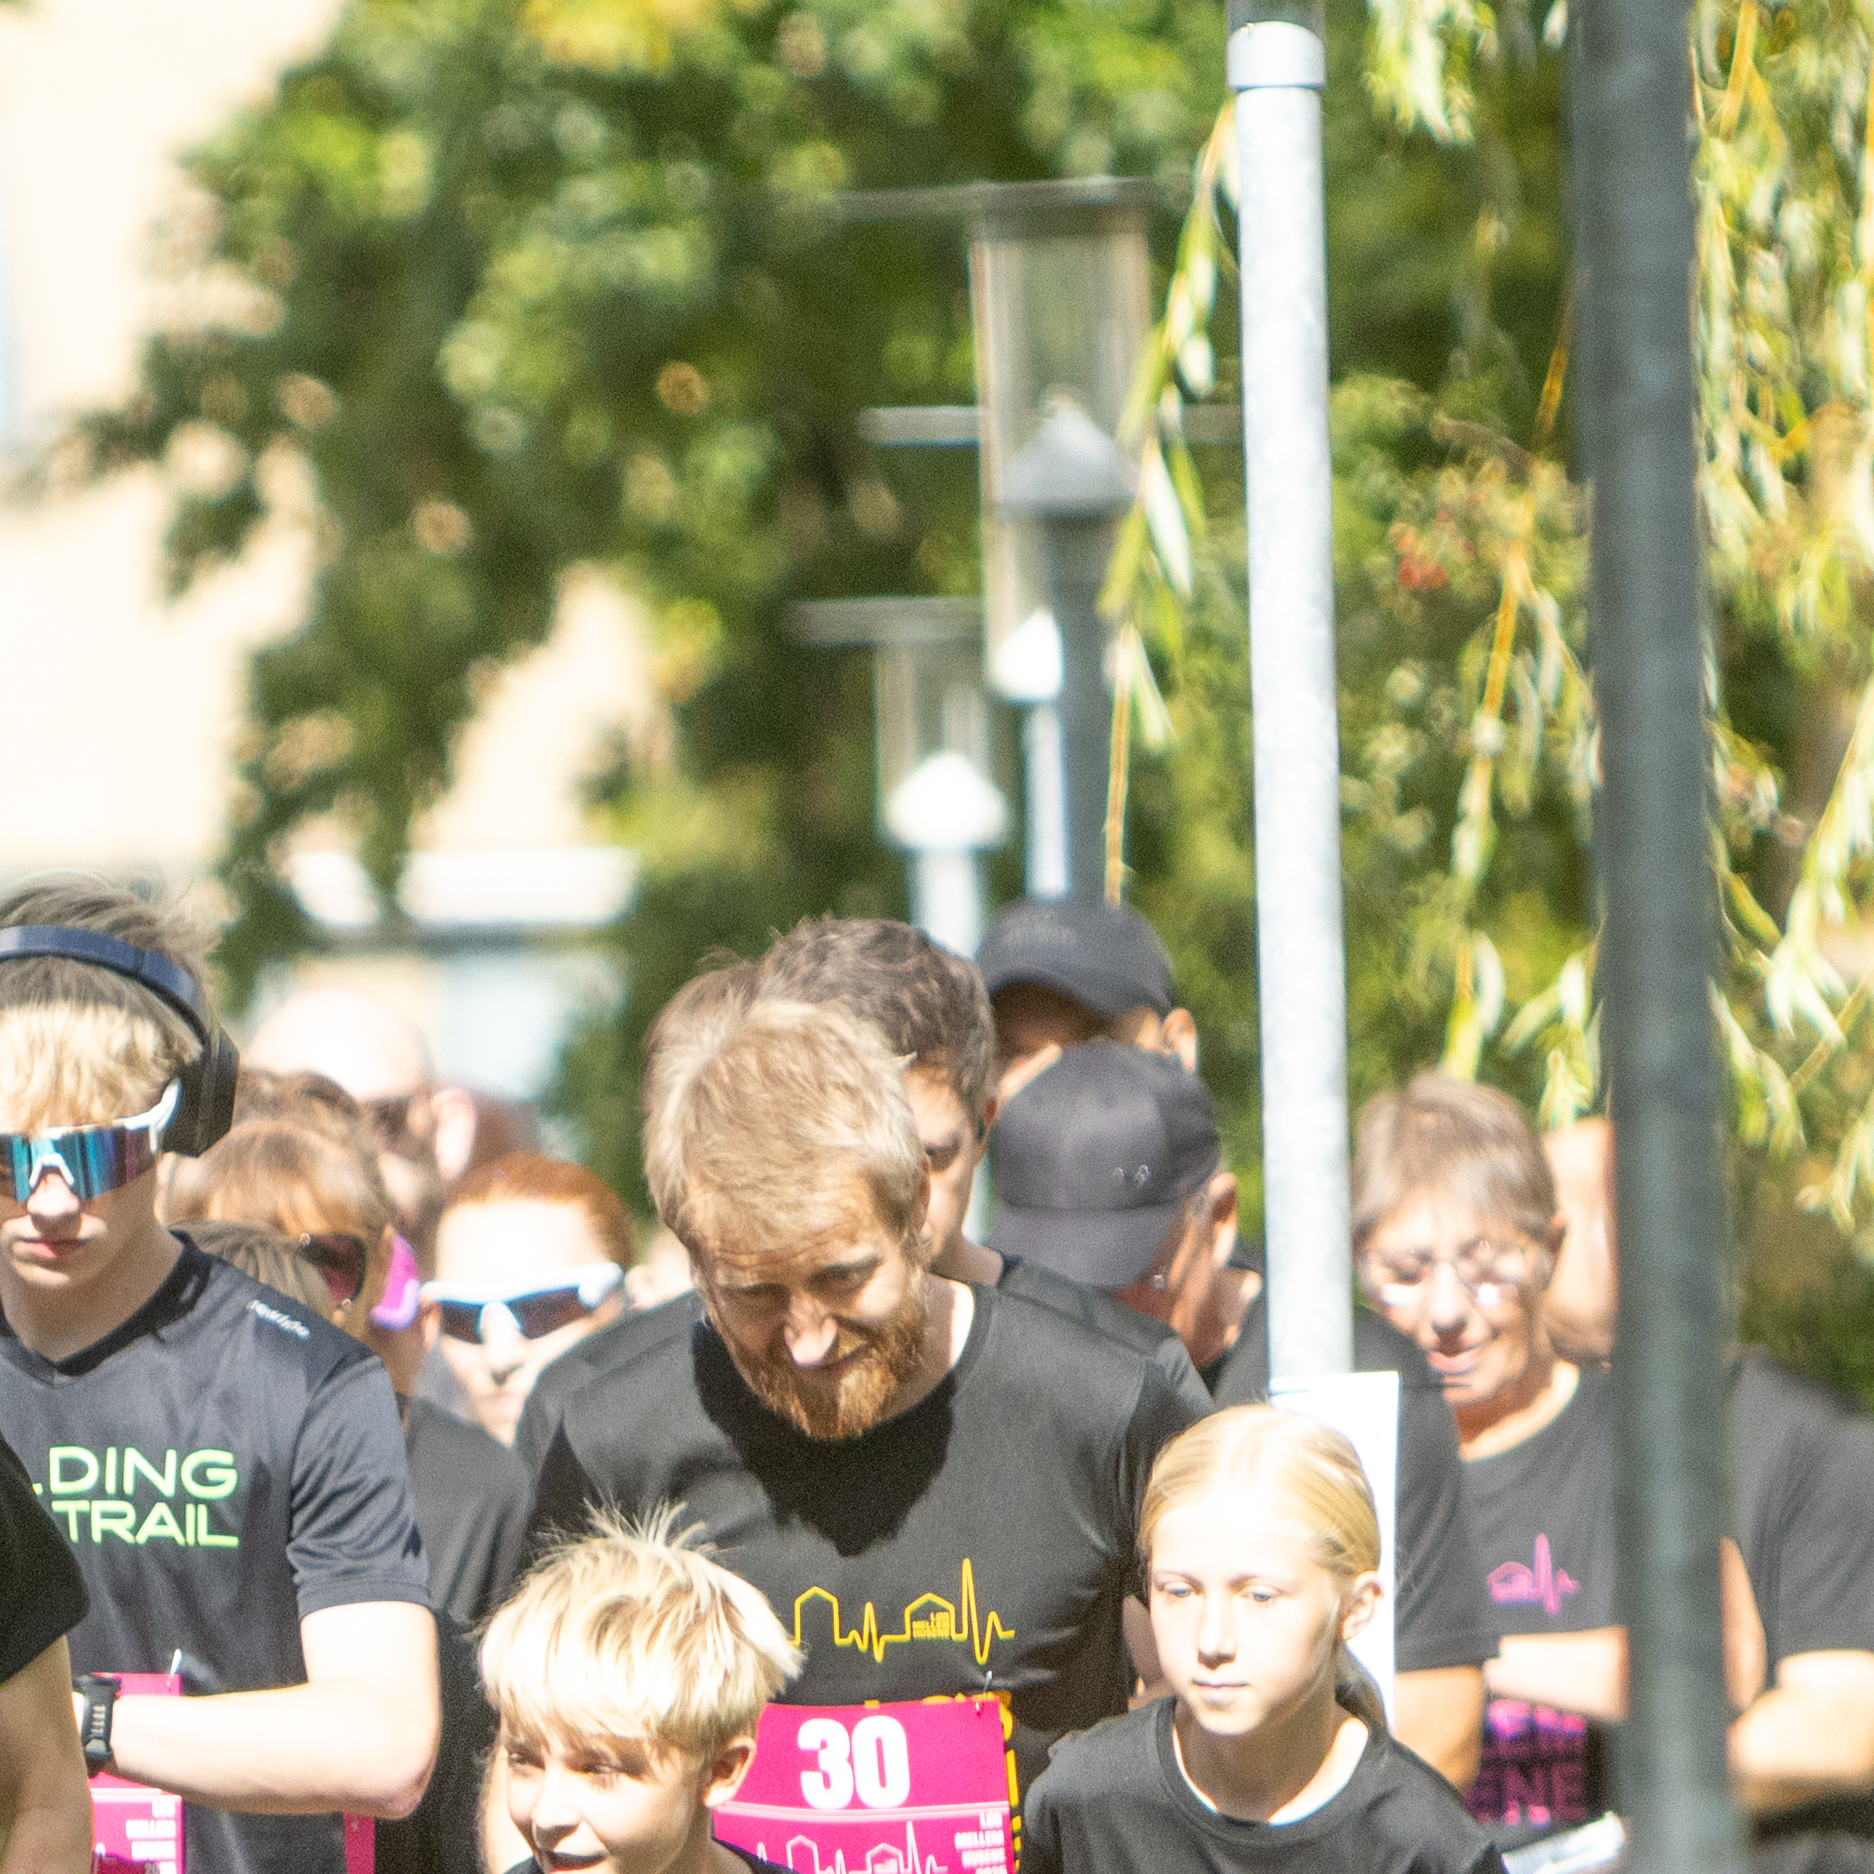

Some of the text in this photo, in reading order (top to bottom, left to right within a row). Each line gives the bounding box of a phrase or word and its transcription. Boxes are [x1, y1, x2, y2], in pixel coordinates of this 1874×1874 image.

[32, 1446, 238, 1499] DING
[51, 1499, 240, 1548] TRAIL
[798, 1715, 910, 1809] 30
